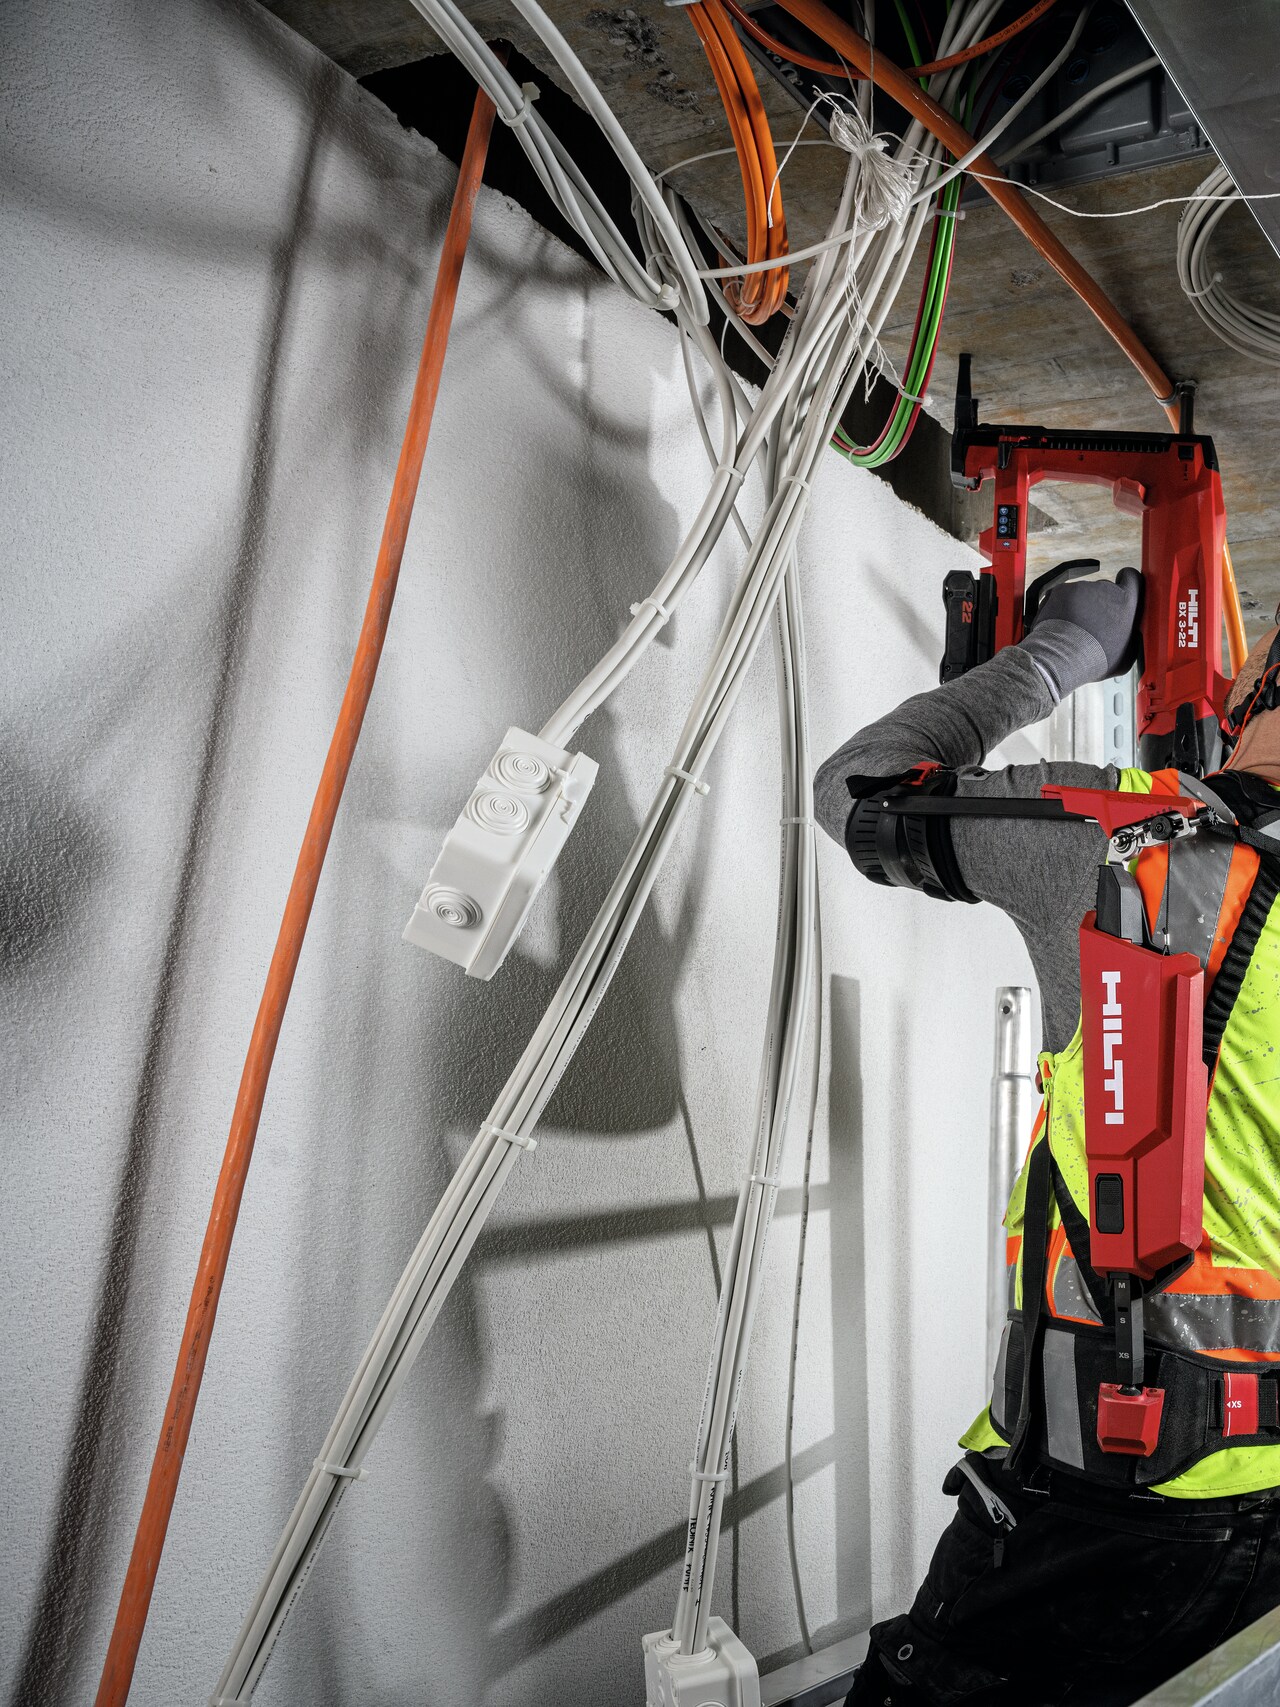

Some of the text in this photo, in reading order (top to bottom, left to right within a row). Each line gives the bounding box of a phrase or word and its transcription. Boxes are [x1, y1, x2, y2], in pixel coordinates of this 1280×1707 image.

[961, 600, 974, 624] 22
[1178, 601, 1187, 648] BX 3-22
[1187, 588, 1199, 648] HILTI
[1101, 970, 1125, 1126] HILTI
[1231, 1400, 1242, 1409] XS
